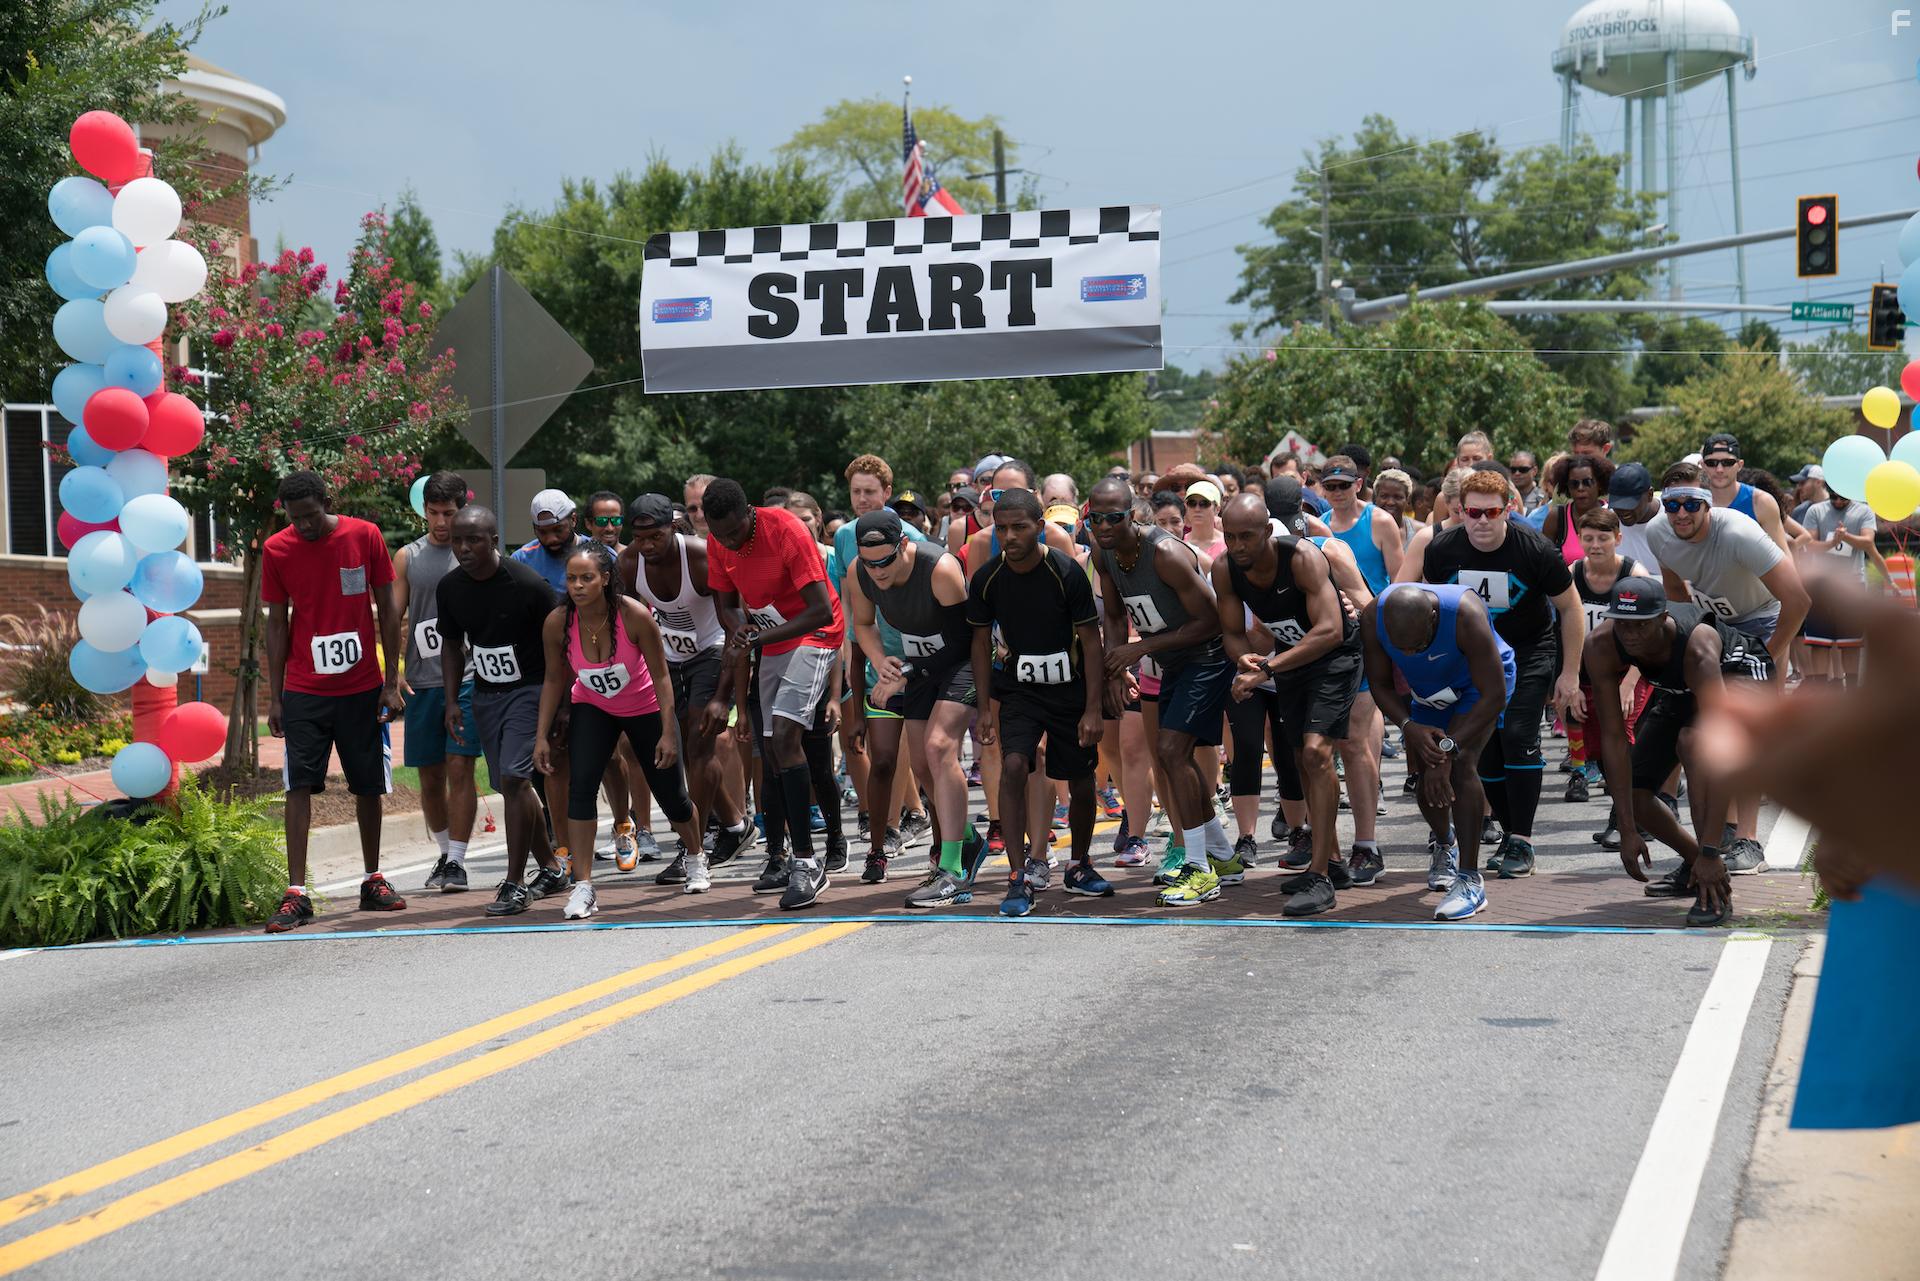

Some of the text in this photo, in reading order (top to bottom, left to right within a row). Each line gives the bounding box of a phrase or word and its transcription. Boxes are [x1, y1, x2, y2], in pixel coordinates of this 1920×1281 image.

[1616, 9, 1631, 19] OF
[748, 257, 1053, 339] START
[1478, 577, 1491, 603] 4
[1695, 594, 1733, 616] 116
[318, 638, 359, 667] 130
[662, 633, 698, 654] 129
[908, 640, 938, 656] 76
[477, 652, 516, 677] 135
[1021, 659, 1065, 684] 311
[589, 671, 622, 694] 95
